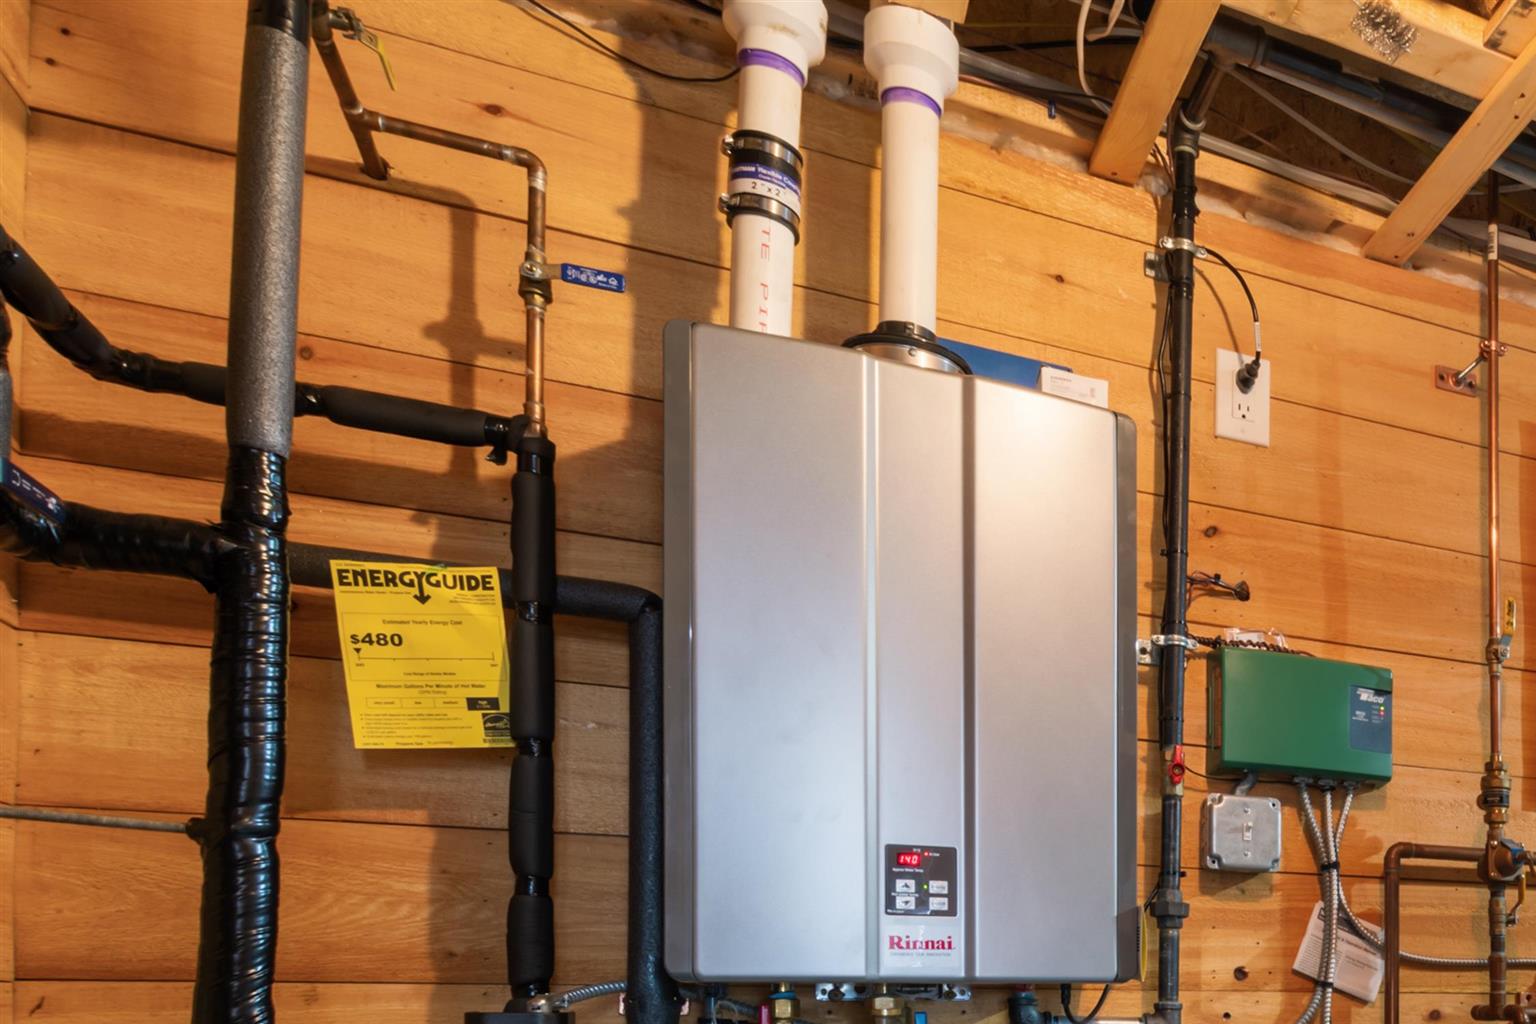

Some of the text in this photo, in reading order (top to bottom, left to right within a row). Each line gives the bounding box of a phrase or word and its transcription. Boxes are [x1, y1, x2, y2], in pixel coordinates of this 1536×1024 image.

[336, 568, 496, 596] ENERGYGUIDE
[350, 633, 403, 647] $480
[899, 855, 919, 865] 140
[888, 934, 954, 951] Rinnai
